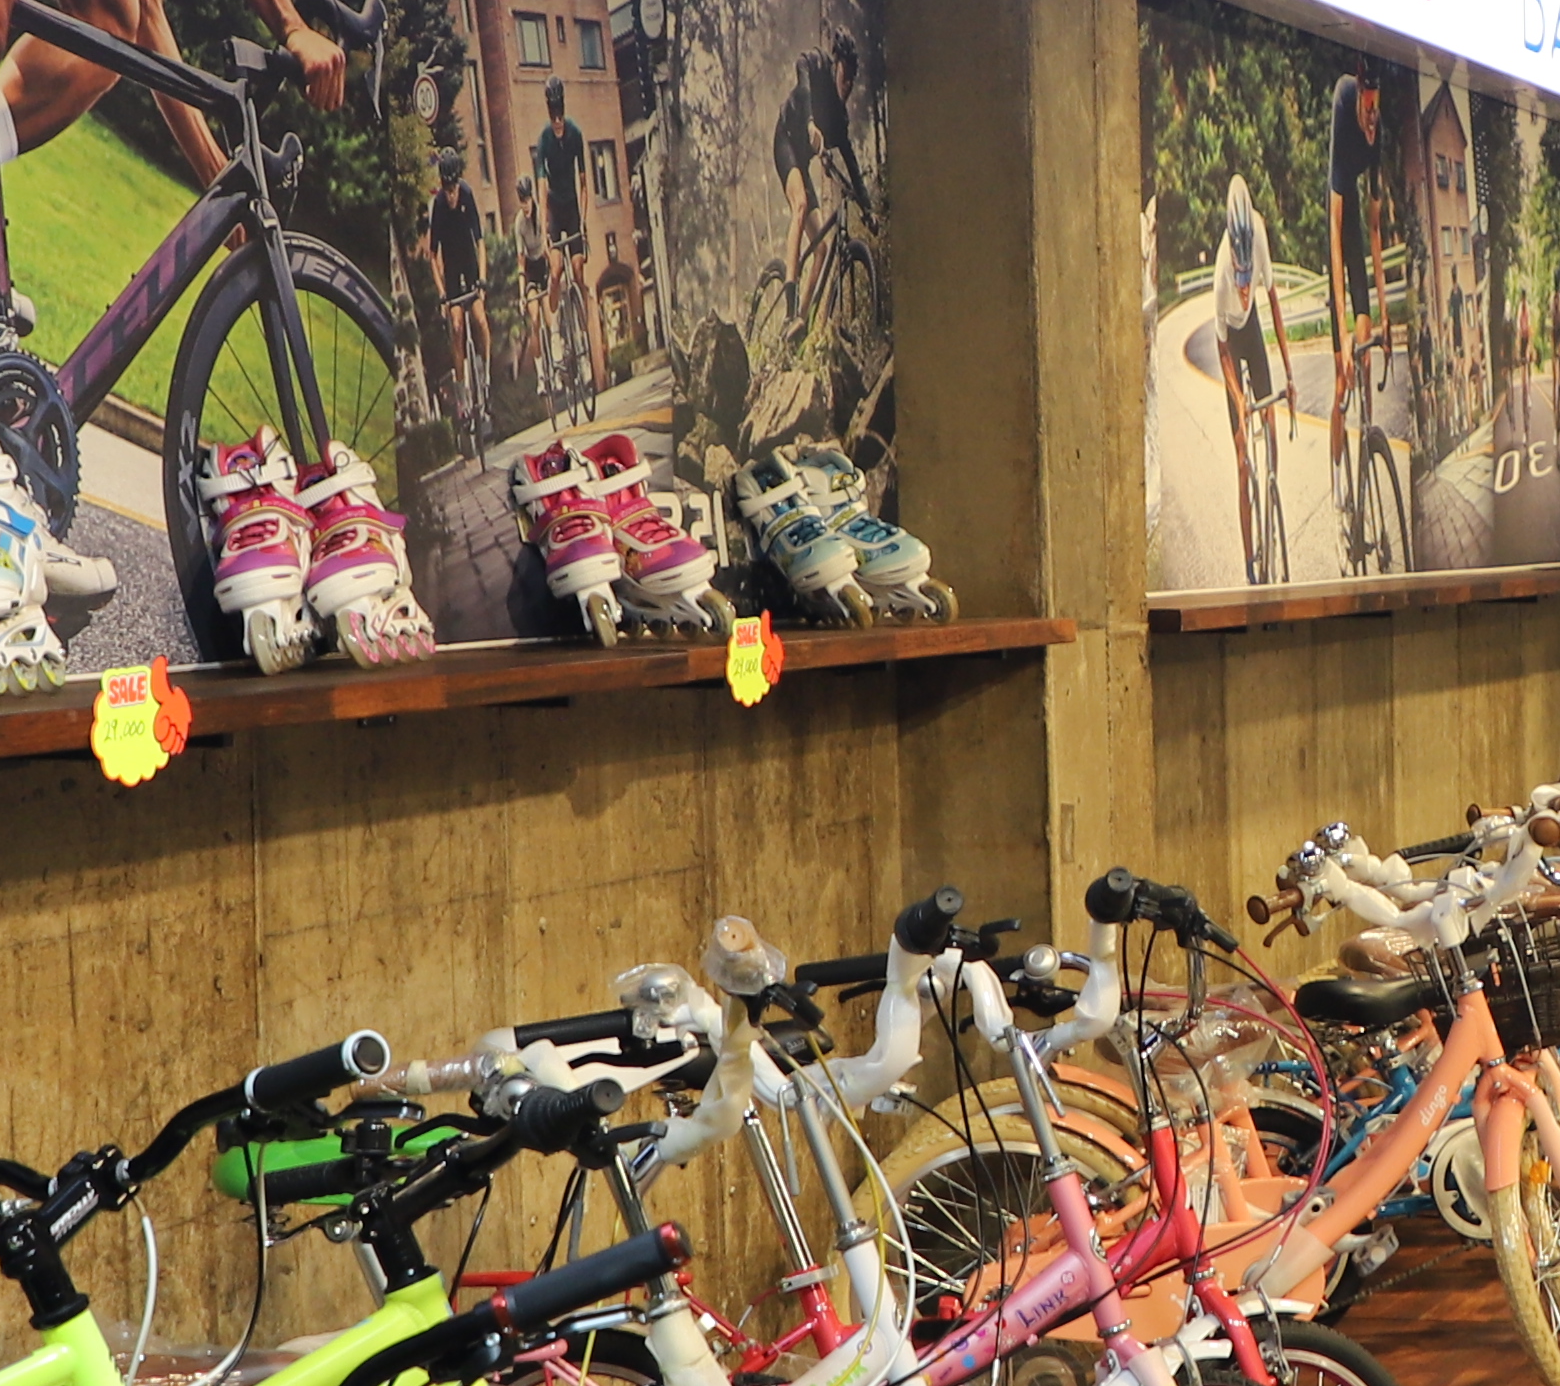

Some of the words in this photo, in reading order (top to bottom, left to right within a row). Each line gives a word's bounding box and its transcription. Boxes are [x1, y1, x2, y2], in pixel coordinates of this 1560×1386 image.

[419, 87, 432, 110] 30
[737, 623, 758, 645] SALE
[109, 674, 147, 705] SALE
[103, 718, 145, 743] 29,000
[1419, 1084, 1447, 1127] dingo
[1015, 1289, 1069, 1329] LINK
